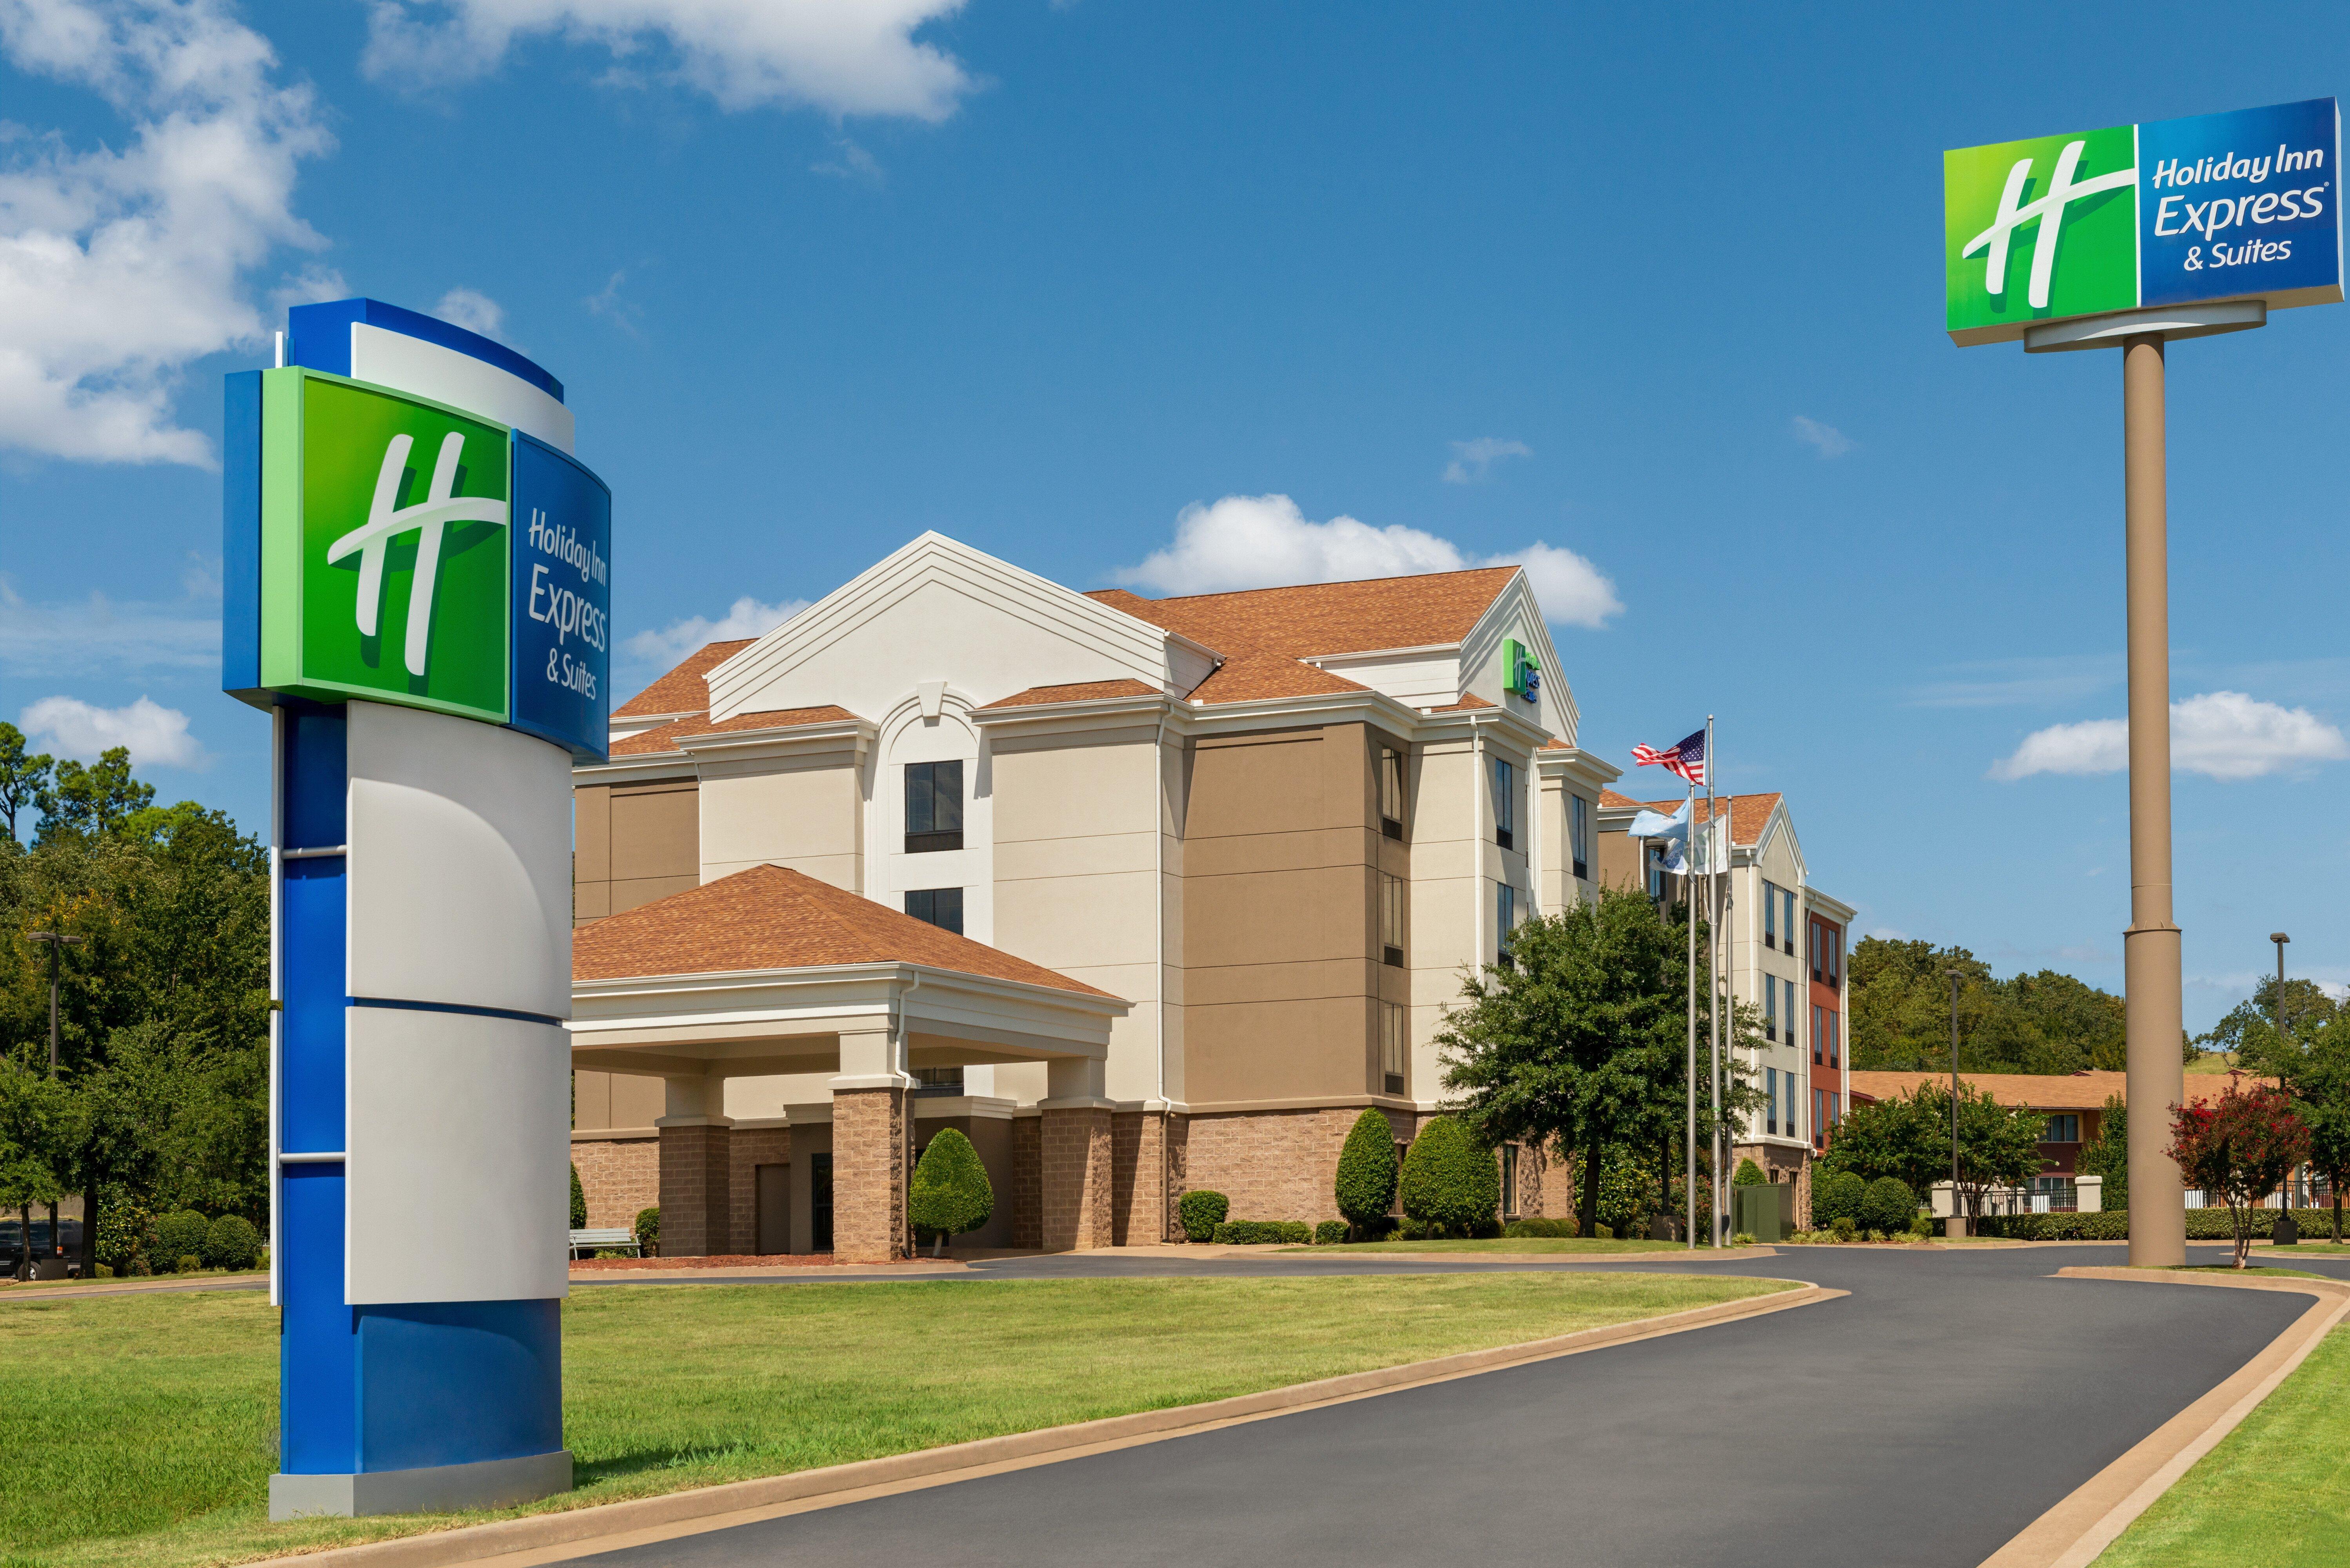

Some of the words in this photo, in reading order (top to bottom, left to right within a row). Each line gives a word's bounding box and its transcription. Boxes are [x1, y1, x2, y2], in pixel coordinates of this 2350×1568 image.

[2152, 152, 2272, 189] Holiday
[2275, 143, 2324, 173] Inn
[2184, 246, 2204, 271] &
[2209, 239, 2292, 268] Suites
[528, 508, 591, 583] Holiday
[591, 540, 606, 588] Inn
[529, 563, 606, 652] Express
[547, 648, 558, 683] &
[561, 653, 596, 700] Suites
